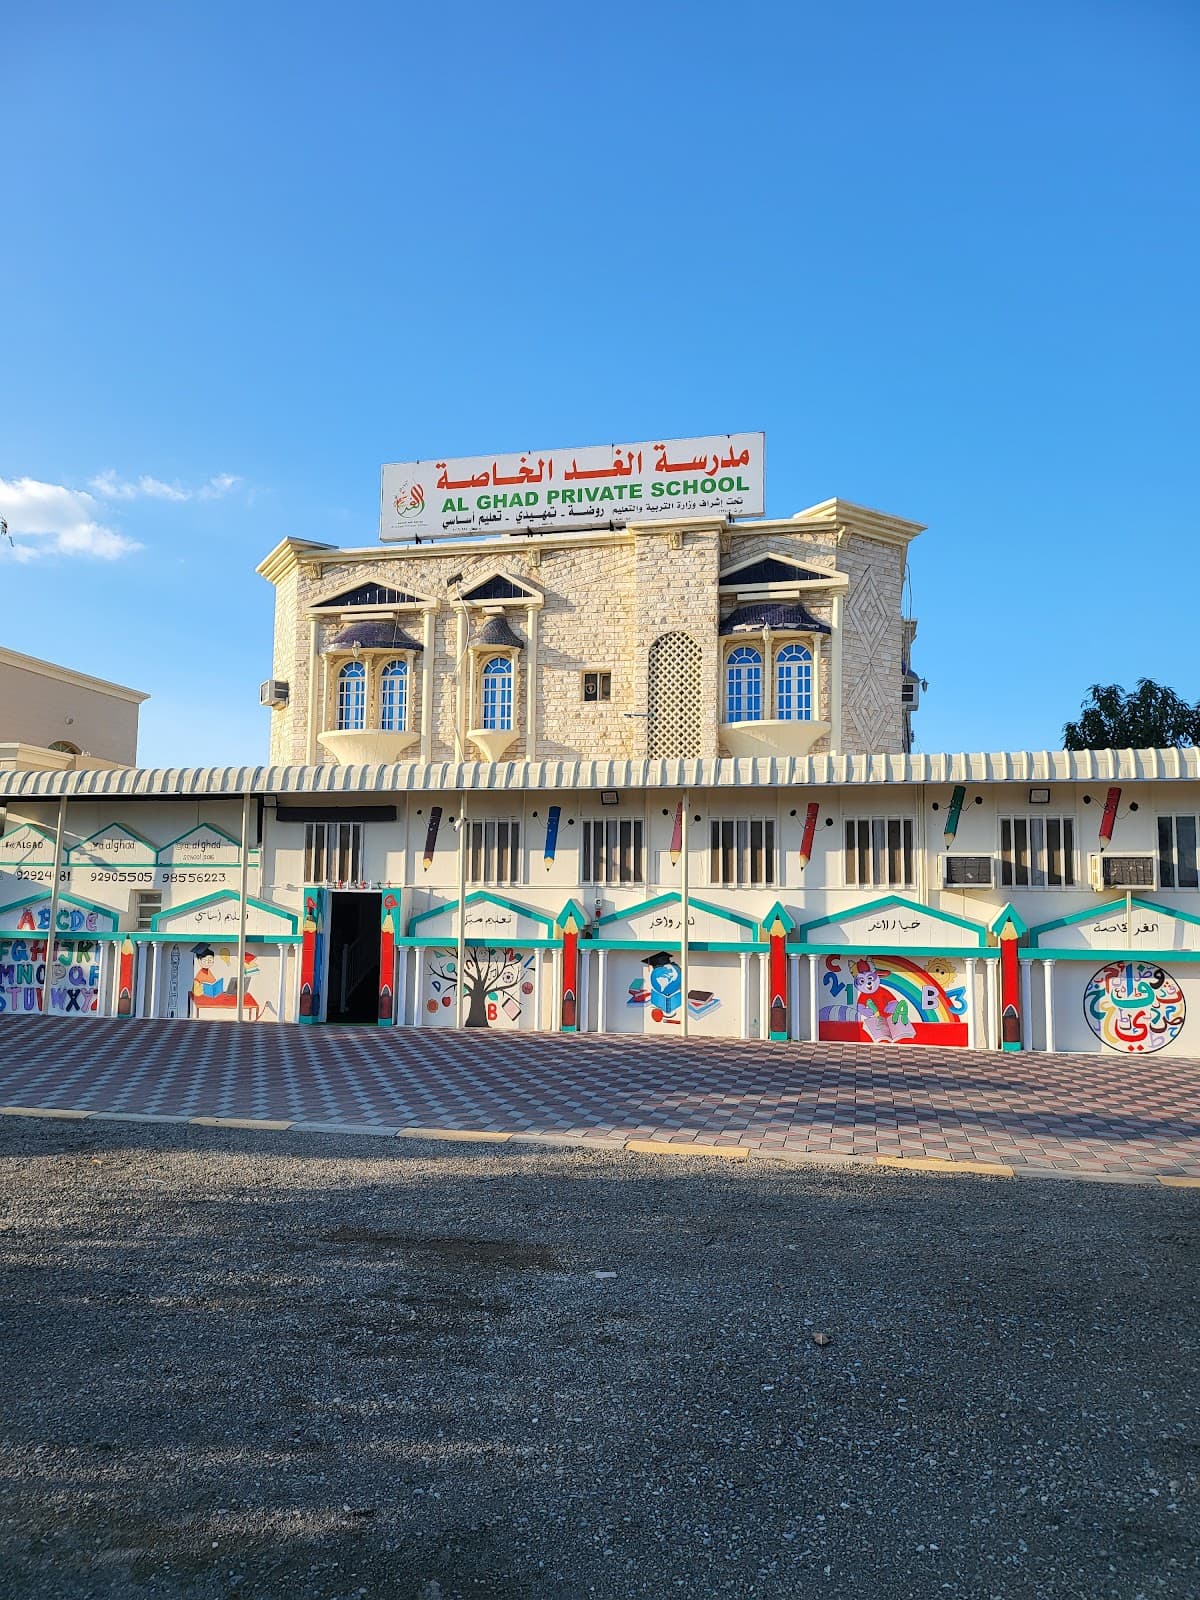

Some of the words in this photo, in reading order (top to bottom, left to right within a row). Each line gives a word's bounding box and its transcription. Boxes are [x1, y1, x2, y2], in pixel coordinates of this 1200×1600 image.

[564, 449, 642, 481] الغد
[653, 444, 750, 476] مدرسة
[435, 456, 553, 490] الخاصة
[441, 497, 469, 513] AL
[476, 491, 539, 509] GHAD
[546, 483, 643, 505] PRIVATE
[651, 476, 750, 498] SCHOOL
[568, 504, 605, 518] روضة
[612, 504, 643, 515] والتعليم
[645, 503, 674, 512] التربية
[676, 500, 696, 510] وزارة
[442, 511, 475, 529] أساسي
[478, 510, 502, 526] تعليم
[515, 506, 557, 525] تمهيدي
[16, 871, 71, 882] 9292481
[90, 872, 153, 882] 92905505
[161, 872, 226, 883] 98556223
[825, 954, 842, 973] C
[822, 972, 846, 998] 2
[921, 985, 940, 1010] B
[944, 985, 968, 1015] 3
[487, 1003, 498, 1021] B
[891, 999, 910, 1026] A
